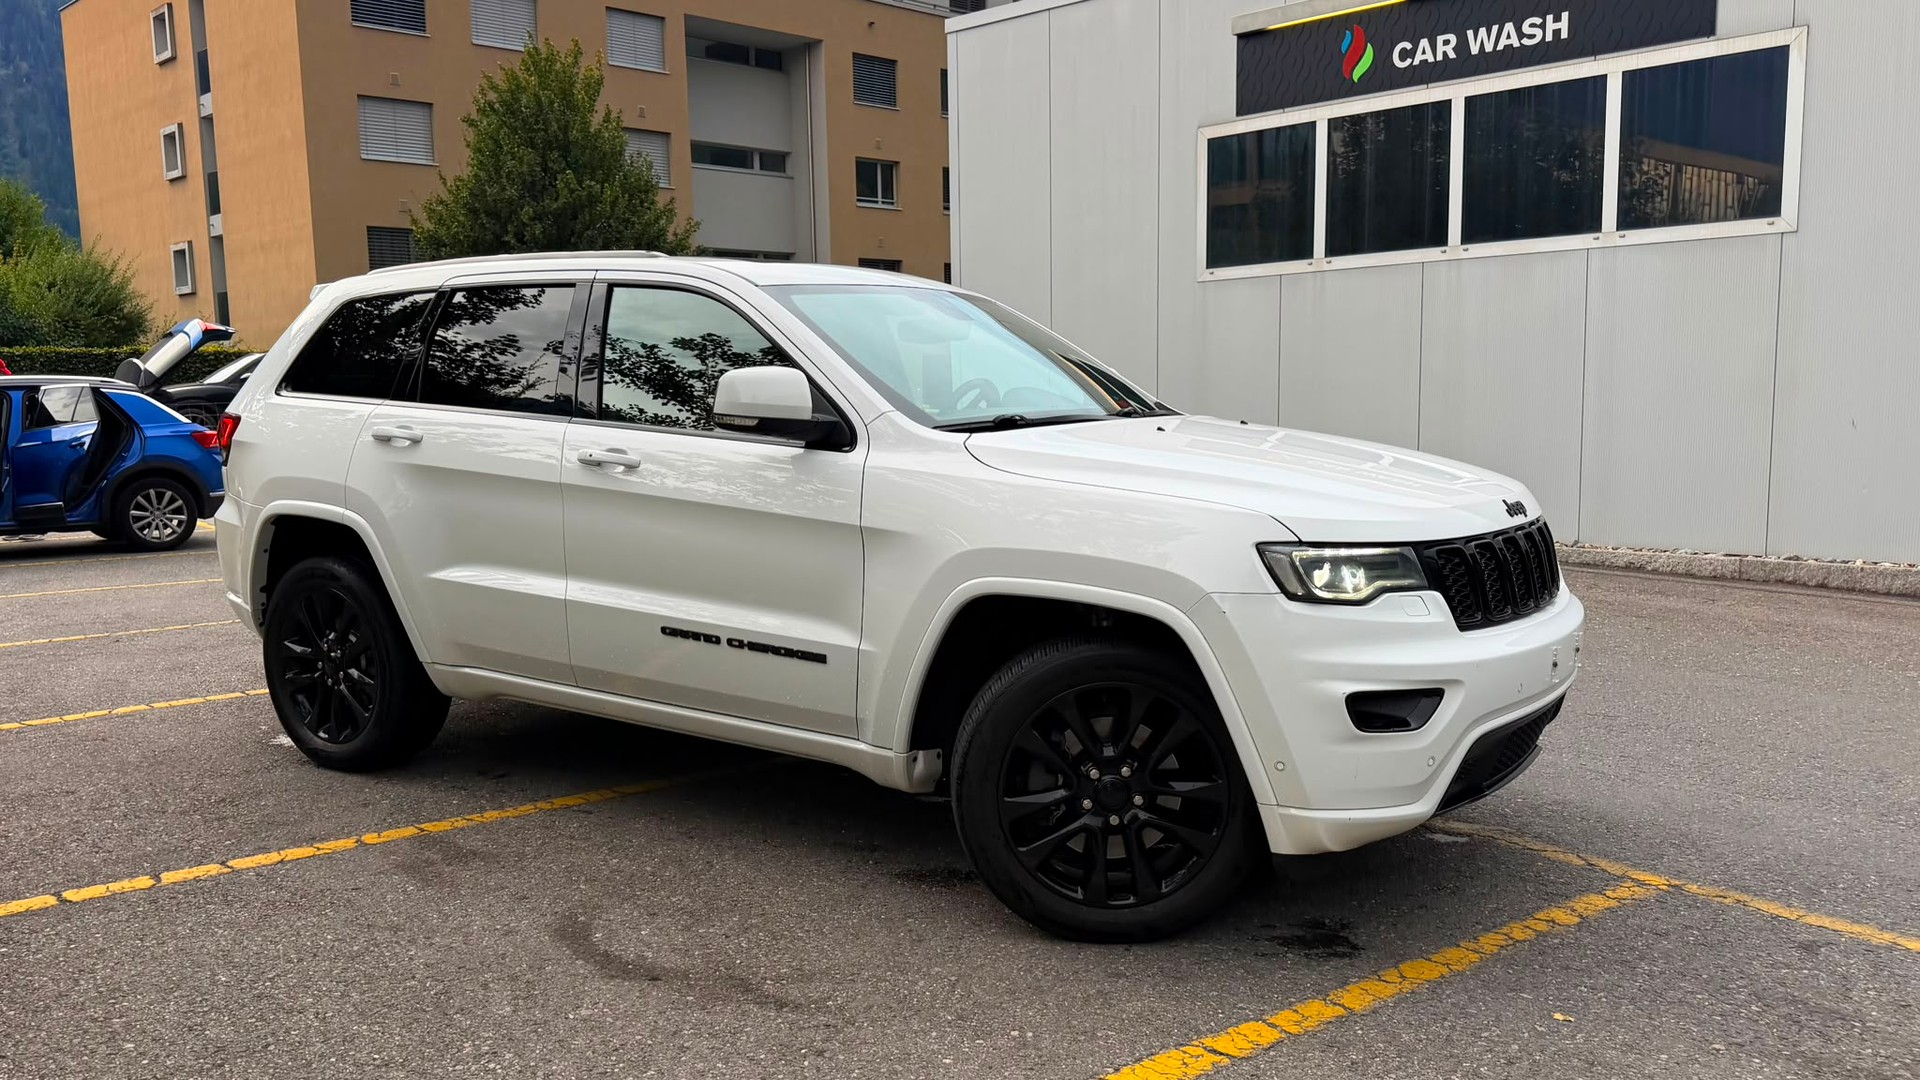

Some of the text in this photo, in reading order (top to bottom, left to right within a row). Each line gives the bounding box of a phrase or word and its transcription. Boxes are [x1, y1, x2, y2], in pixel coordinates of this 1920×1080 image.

[1392, 11, 1570, 68] CAR WASH
[660, 626, 721, 645] GRAND
